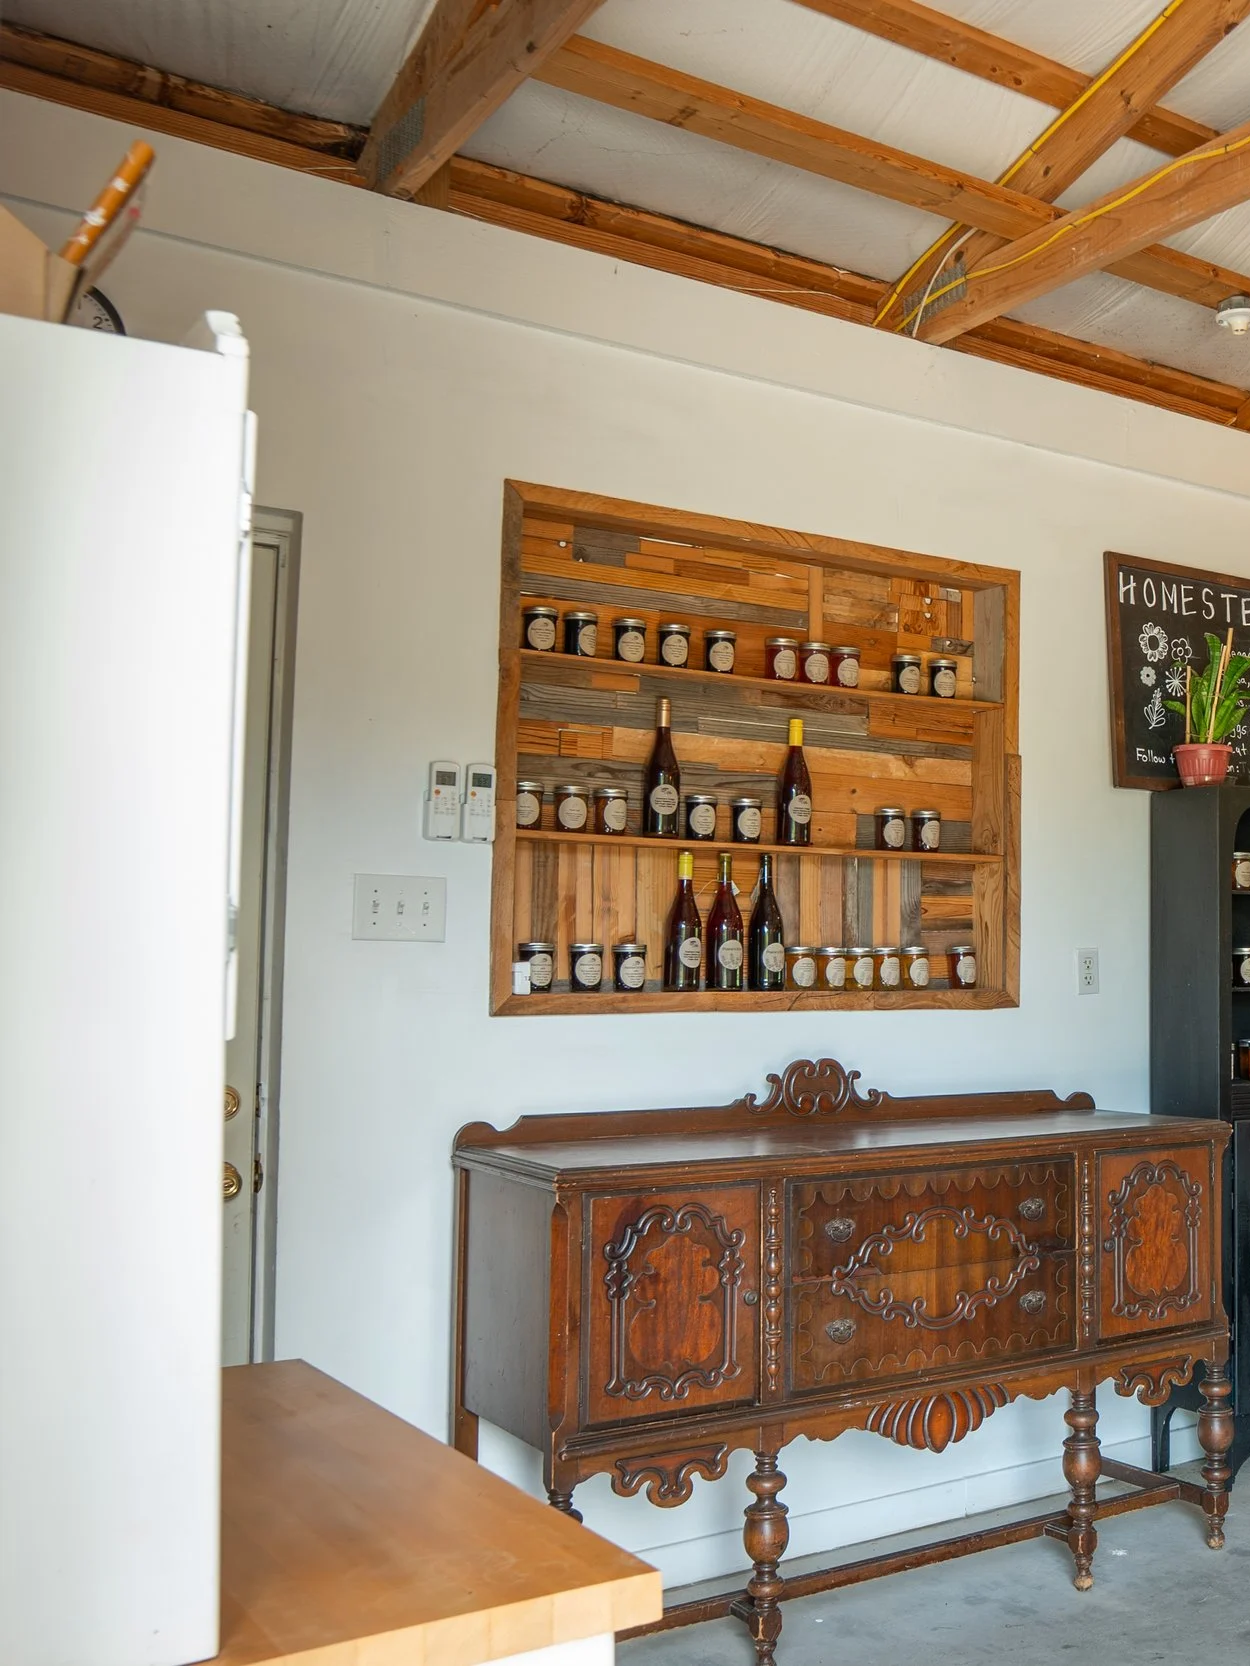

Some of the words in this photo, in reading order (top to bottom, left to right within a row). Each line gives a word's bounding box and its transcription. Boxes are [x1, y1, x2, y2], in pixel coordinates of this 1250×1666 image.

[92, 315, 103, 329] 2
[1229, 724, 1248, 740] ggs
[1136, 747, 1166, 764] Follow
